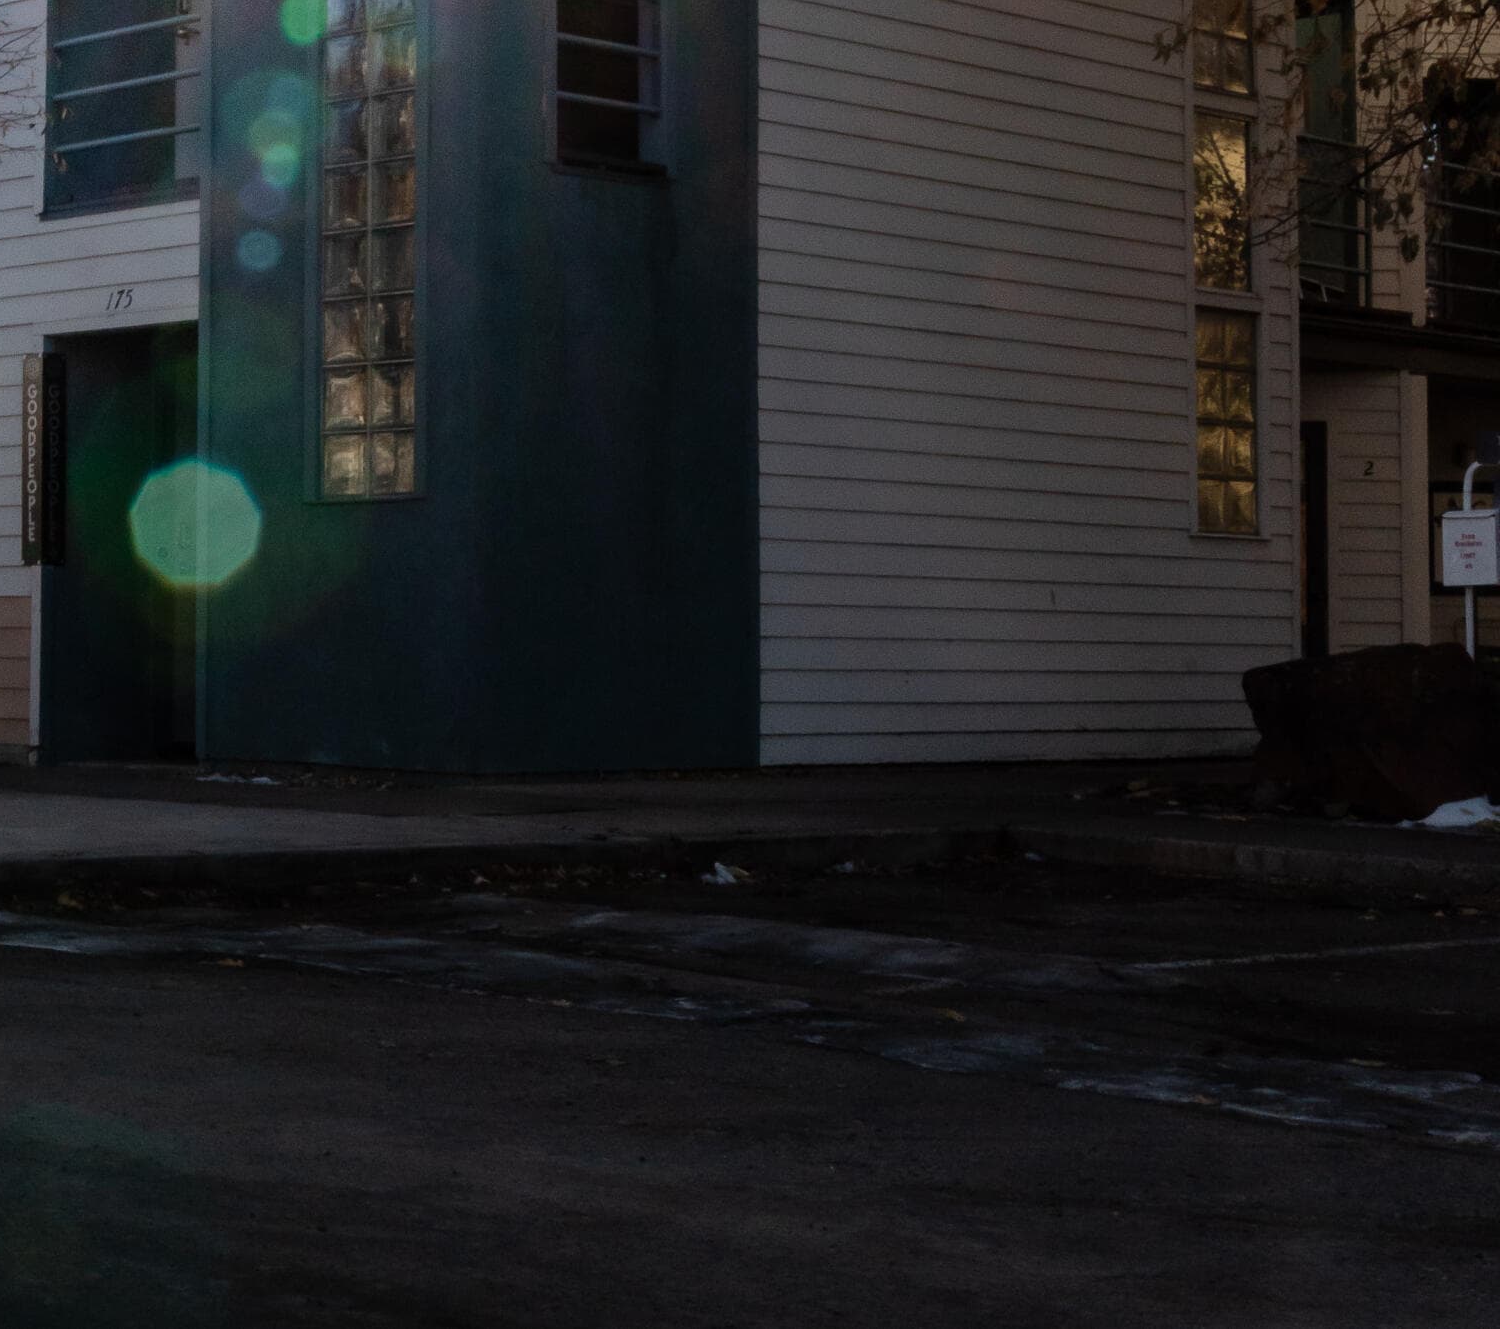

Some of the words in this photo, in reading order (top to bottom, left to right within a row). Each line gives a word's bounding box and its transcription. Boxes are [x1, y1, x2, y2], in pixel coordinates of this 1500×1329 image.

[106, 288, 133, 311] 175
[27, 383, 38, 543] GOODPEOPLE
[1363, 460, 1374, 476] 2
